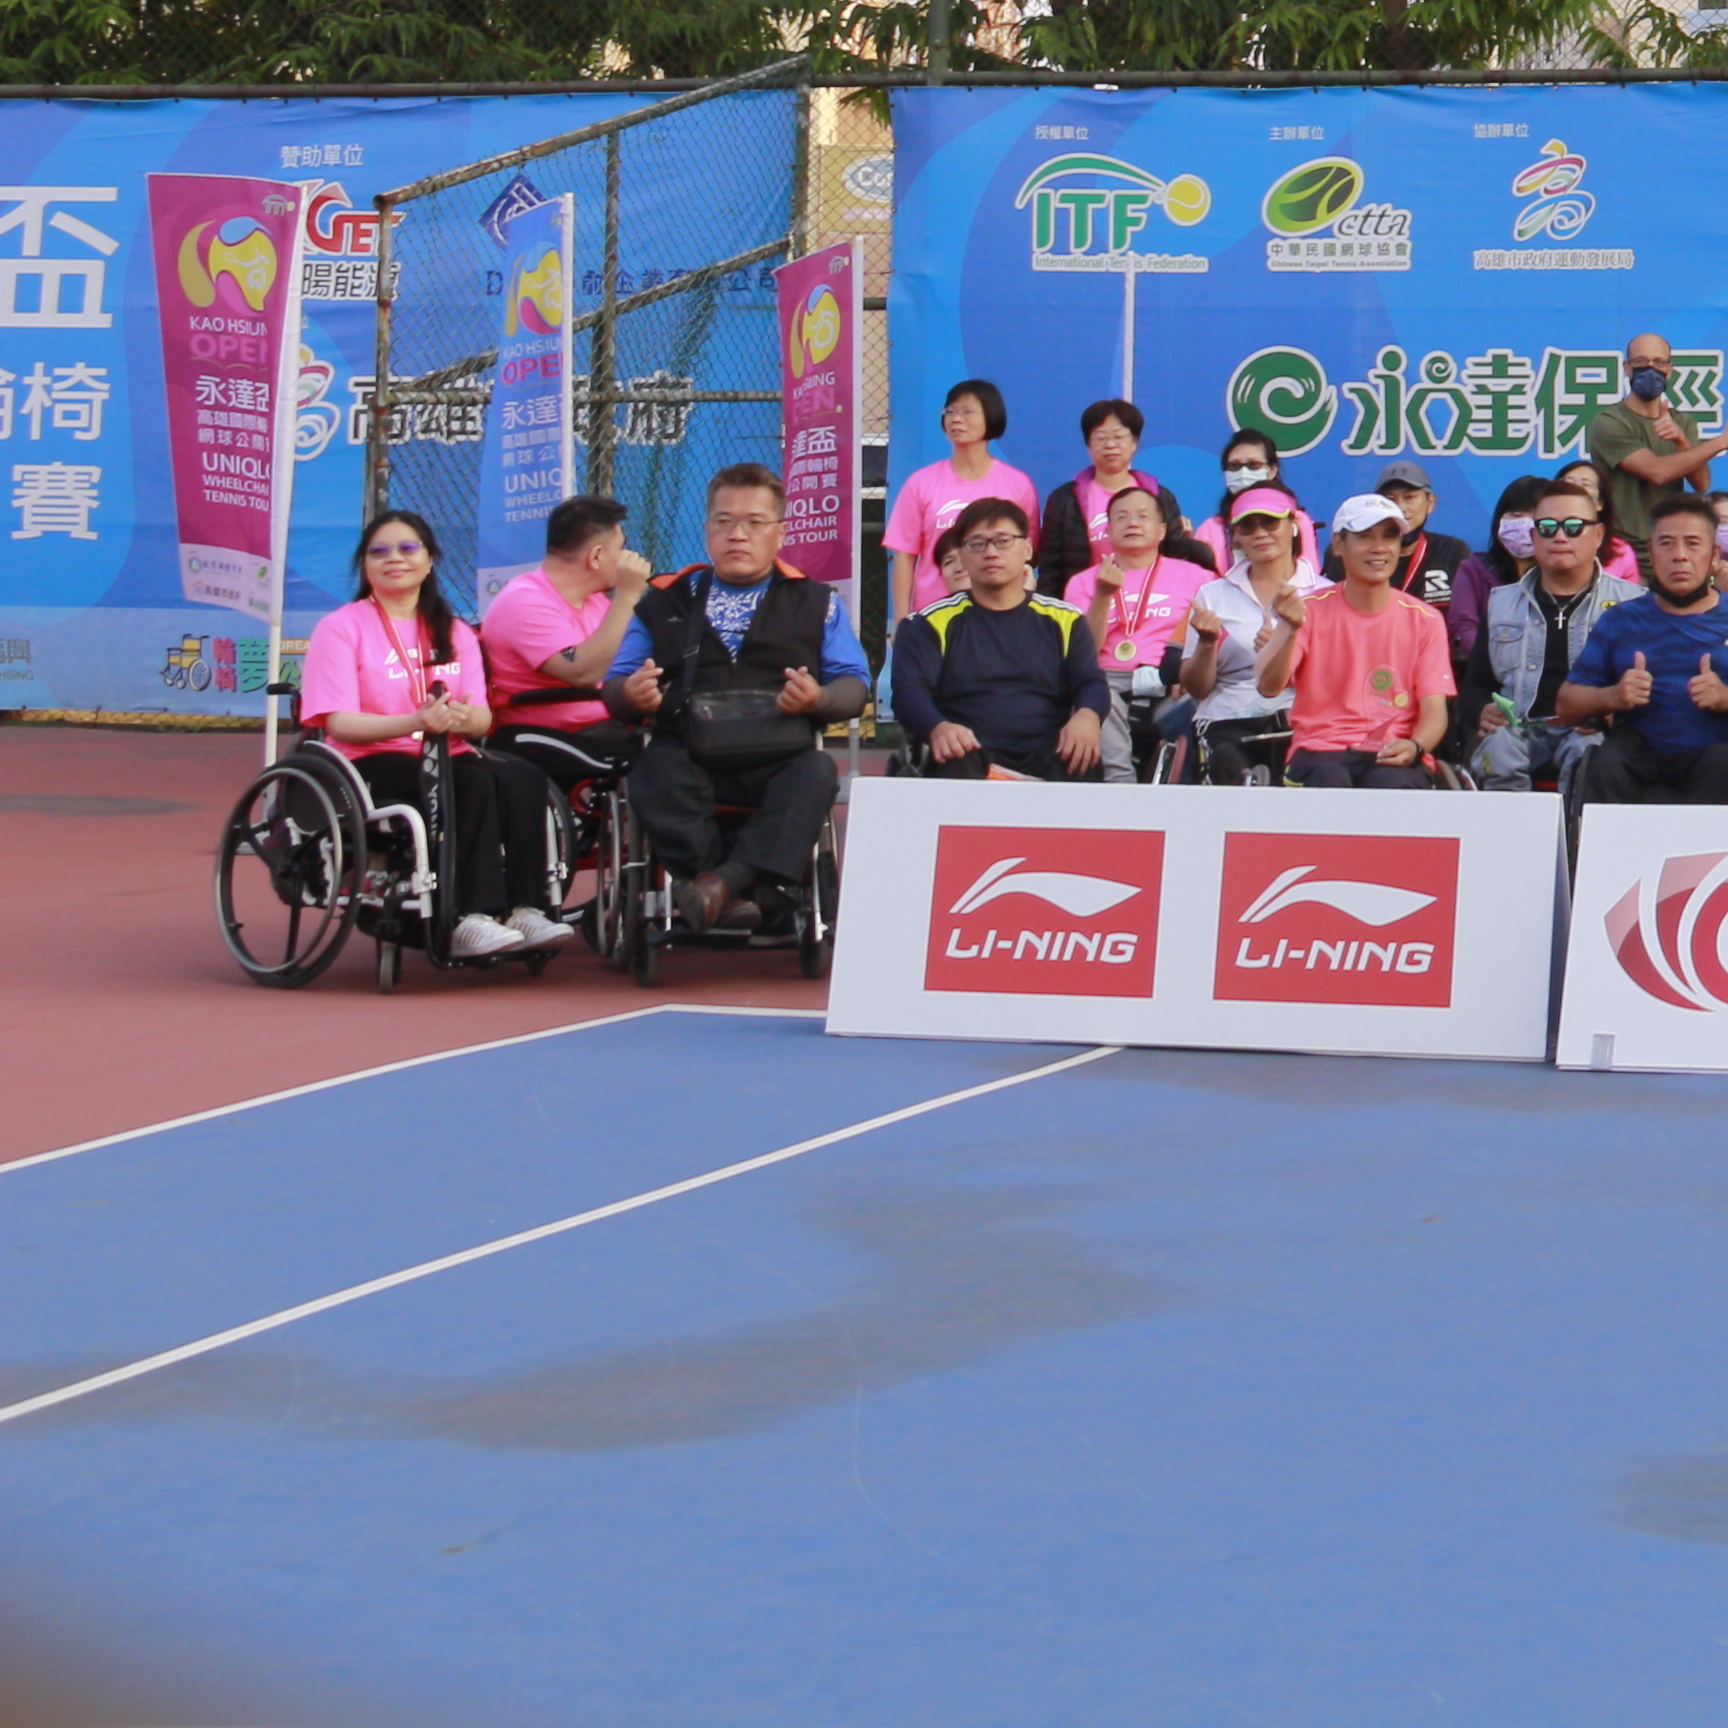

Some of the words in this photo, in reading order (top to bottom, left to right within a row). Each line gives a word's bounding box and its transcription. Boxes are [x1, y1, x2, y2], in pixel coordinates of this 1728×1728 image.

[1036, 192, 1151, 251] ITF
[1270, 241, 1409, 258] 中華民國網球協會
[1035, 256, 1103, 268] International
[1108, 256, 1143, 268] Tenis
[1149, 255, 1206, 268] Federation
[1271, 260, 1302, 268] Chinese
[1360, 259, 1408, 268] Association
[189, 315, 225, 332] KAO
[502, 353, 563, 385] OPE
[501, 393, 563, 430] 永達
[204, 489, 247, 507] TENNIS
[799, 528, 838, 542] TOUR
[945, 927, 1139, 965] LI-NING
[1234, 936, 1435, 975] LI-NING
